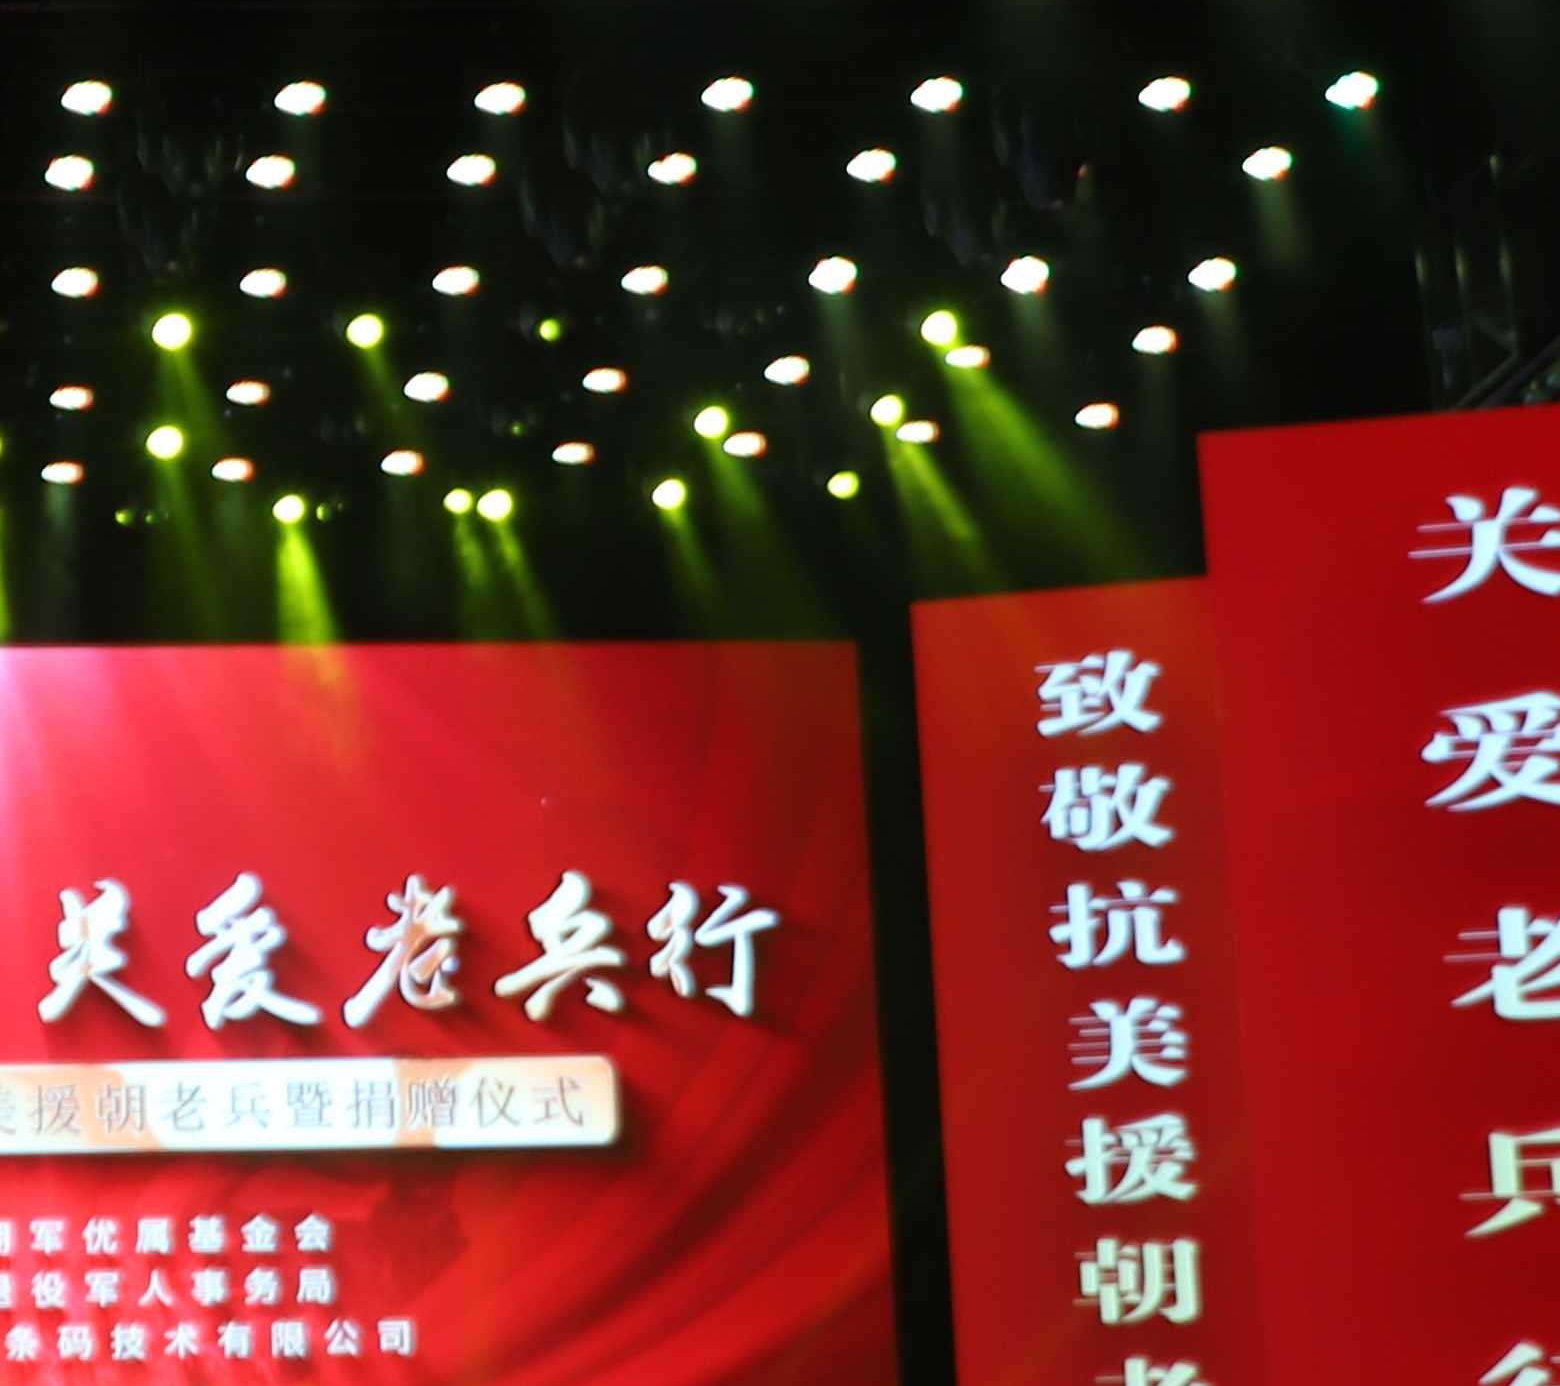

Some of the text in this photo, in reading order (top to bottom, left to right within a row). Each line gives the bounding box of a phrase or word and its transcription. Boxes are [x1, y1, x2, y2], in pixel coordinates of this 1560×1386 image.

[38, 870, 780, 1030] 关爱老兵行
